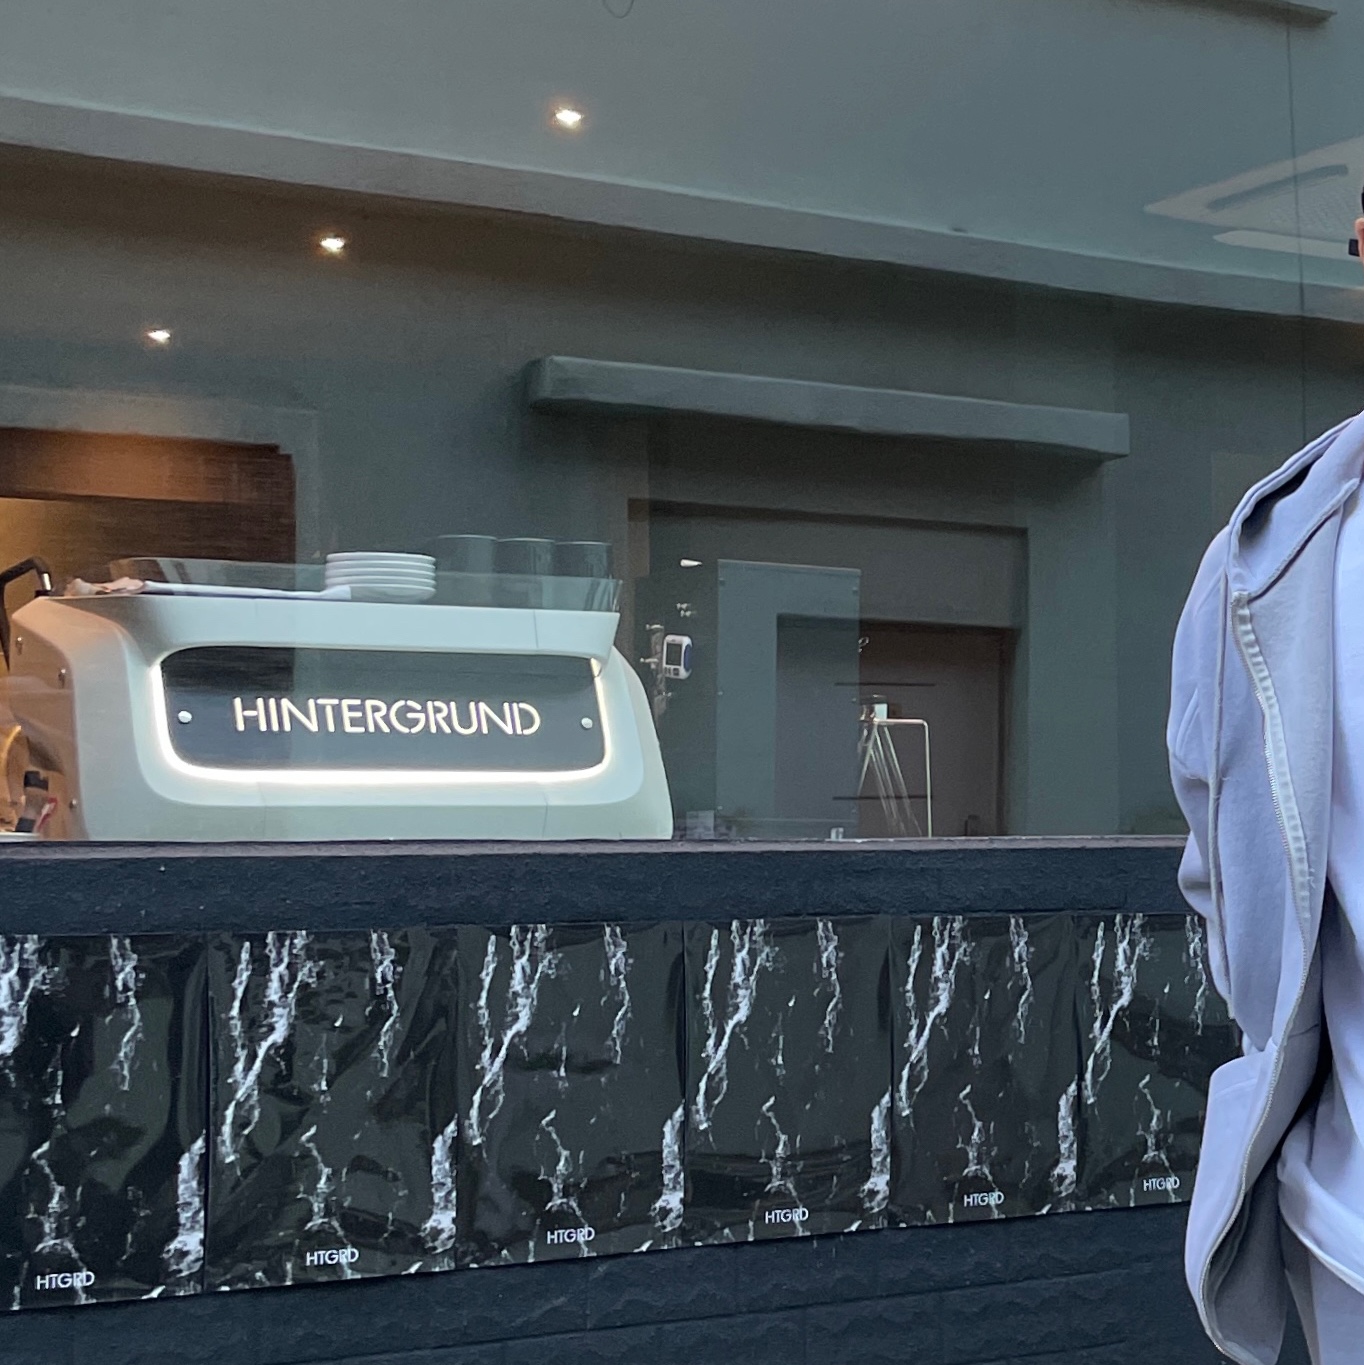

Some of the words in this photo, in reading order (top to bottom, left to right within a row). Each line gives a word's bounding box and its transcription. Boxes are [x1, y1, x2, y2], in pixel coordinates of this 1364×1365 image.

[233, 697, 541, 734] HINTERGRUND
[1143, 1176, 1180, 1190] HTGRD
[964, 1192, 1005, 1207] HTGRD
[765, 1209, 809, 1224] HTGRD
[546, 1226, 596, 1244] HTGRD
[306, 1247, 359, 1265] HTGRD
[36, 1270, 95, 1290] HTGRD
